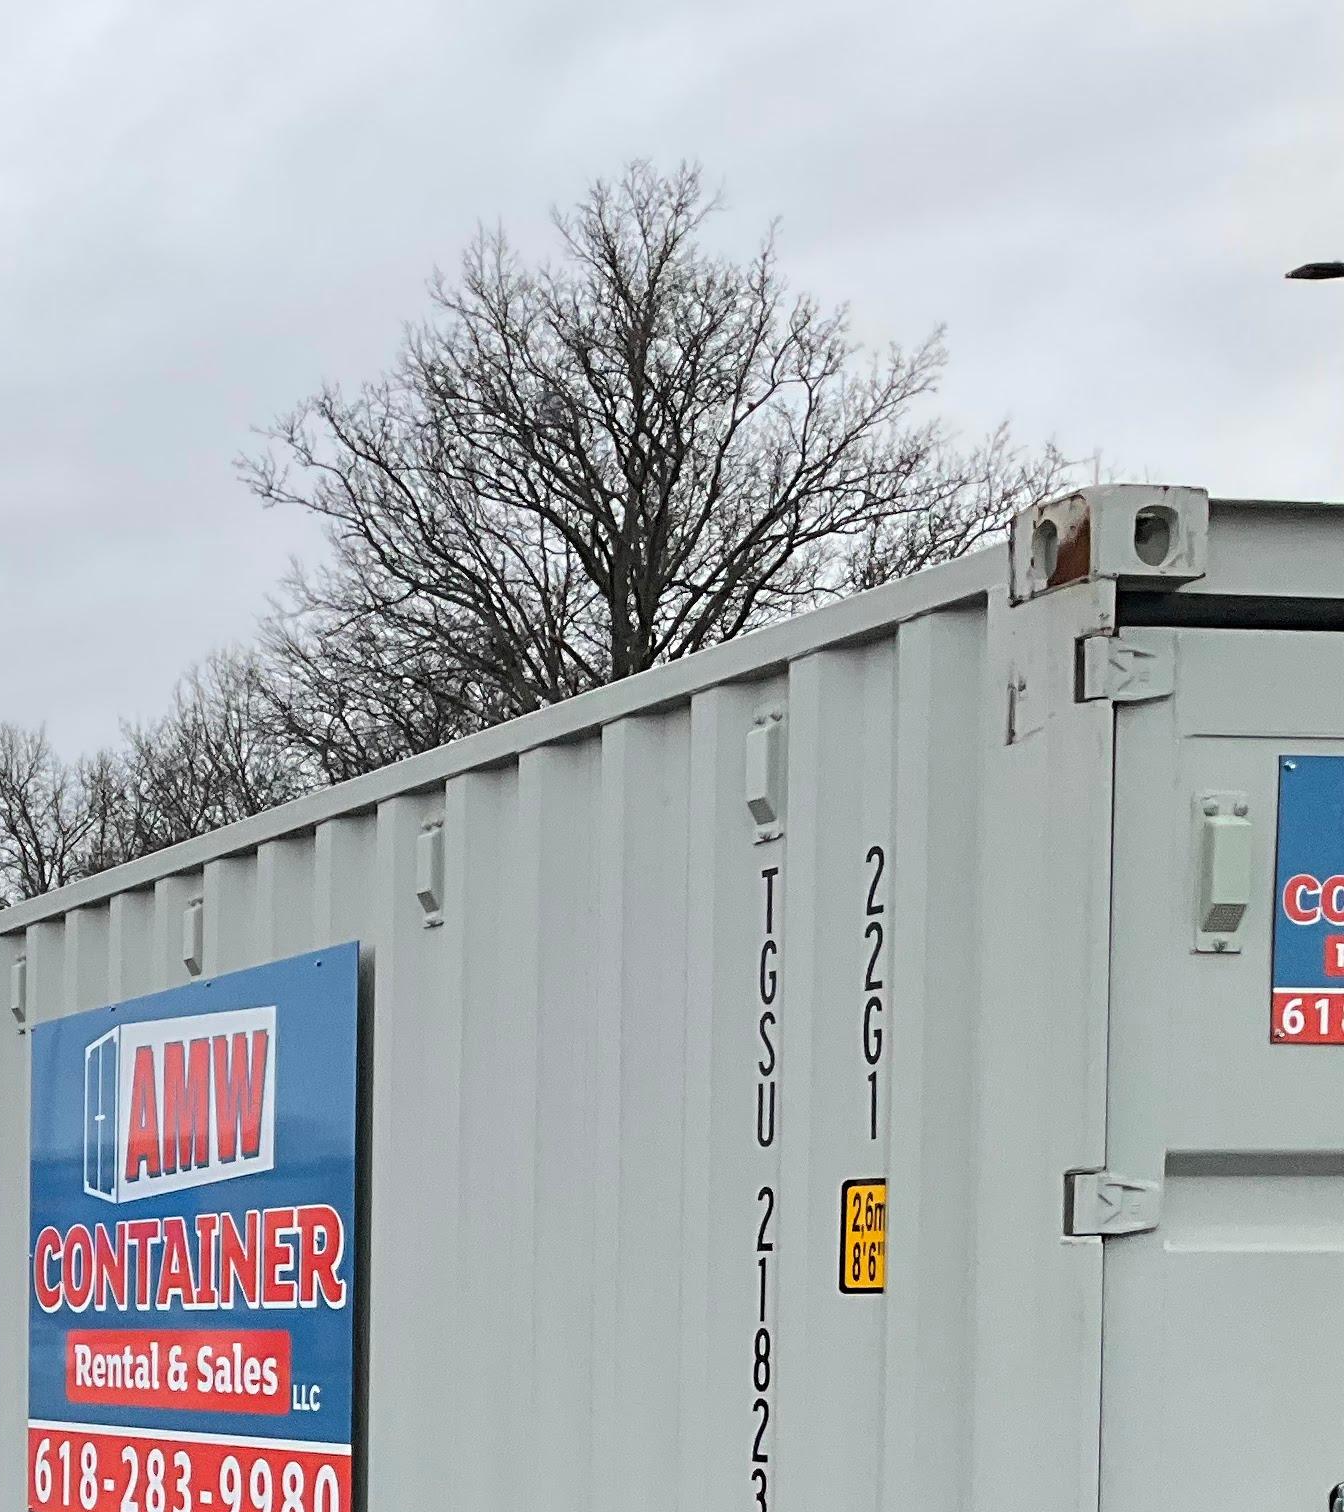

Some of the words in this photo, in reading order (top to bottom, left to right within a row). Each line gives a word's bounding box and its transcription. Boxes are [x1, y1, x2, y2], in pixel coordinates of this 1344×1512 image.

[756, 866, 780, 1147] TGSU
[863, 845, 885, 1140] 22G1
[124, 1027, 270, 1182] AMW
[32, 1203, 348, 1314] CONTAINER
[73, 1343, 160, 1390] Rental
[167, 1349, 190, 1391] &
[196, 1346, 279, 1398] Sales
[292, 1384, 321, 1411] LLC
